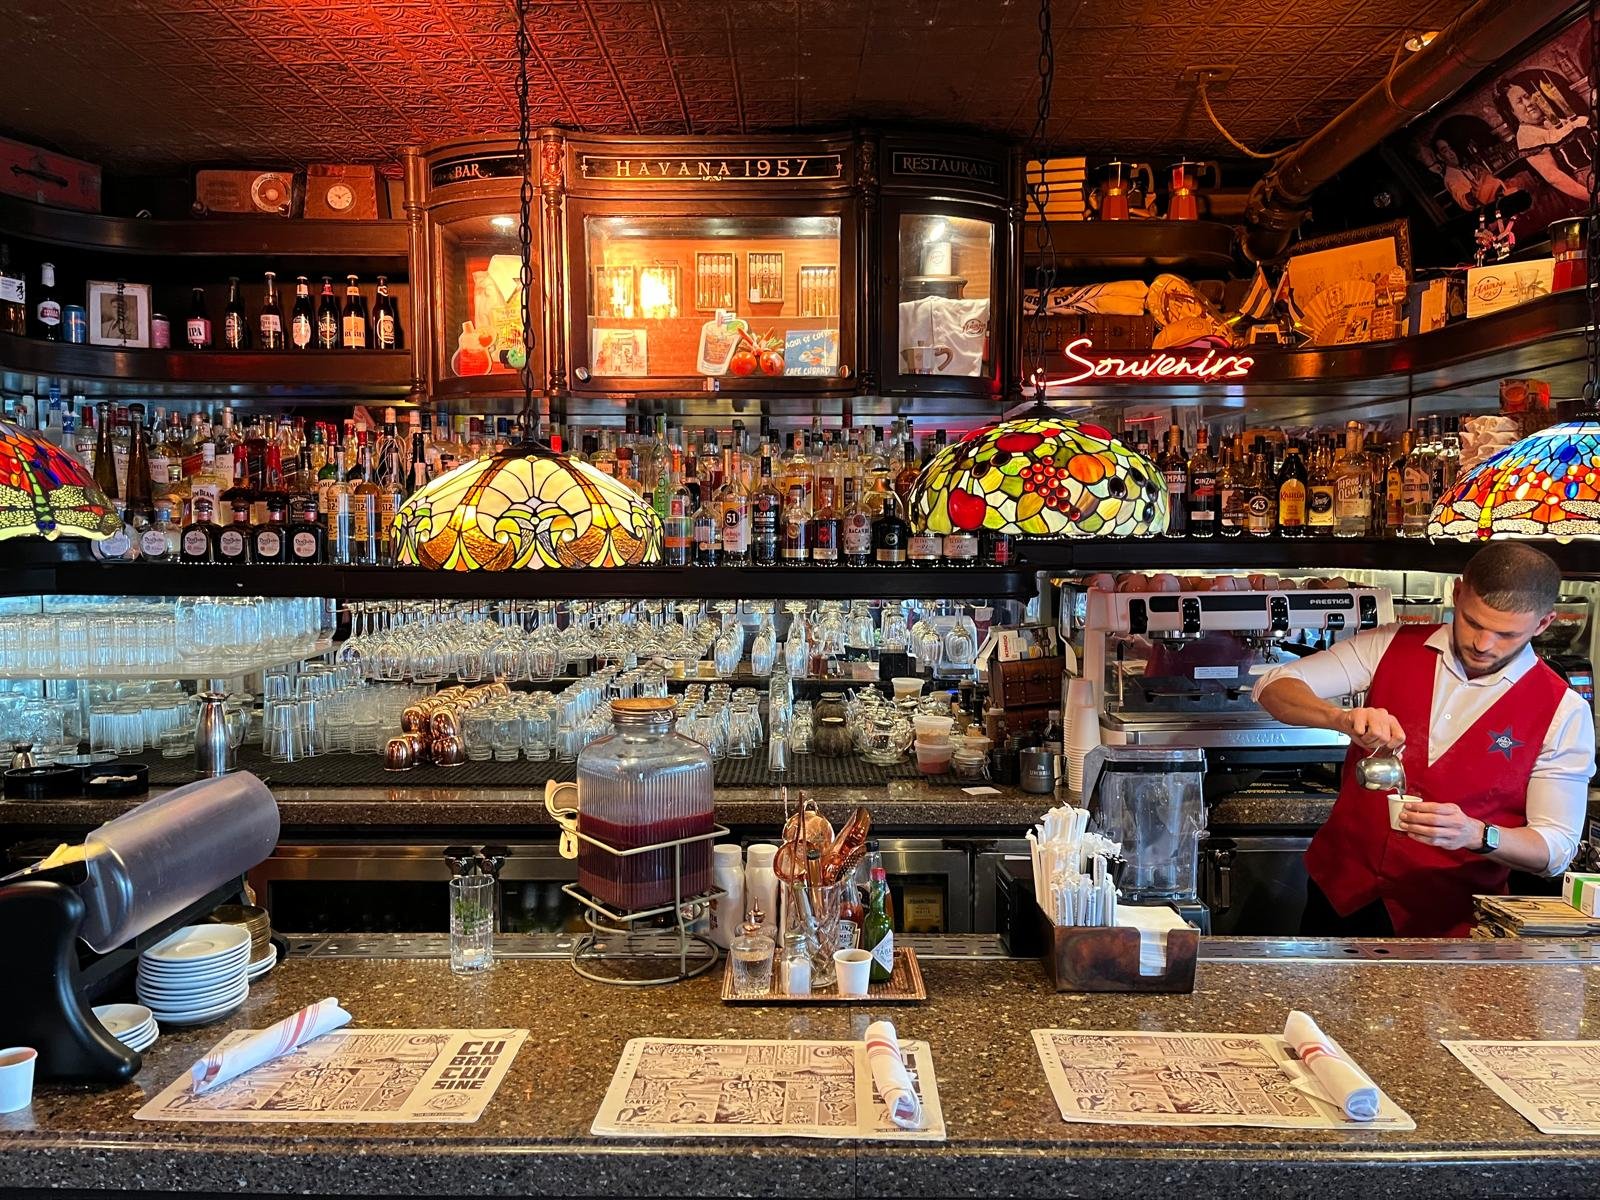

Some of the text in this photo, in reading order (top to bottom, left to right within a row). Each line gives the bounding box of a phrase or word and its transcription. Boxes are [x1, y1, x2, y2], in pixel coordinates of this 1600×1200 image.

[454, 163, 488, 178] BAR
[616, 159, 808, 177] HAVANA 1957
[903, 157, 994, 177] RESTAURANT
[189, 327, 202, 337] IPA
[1031, 338, 1255, 386] Souvenirs
[77, 443, 97, 452] SMIRN
[1252, 500, 1266, 510] 43
[726, 513, 737, 524] 51
[457, 1041, 506, 1055] CU
[449, 1056, 499, 1066] BAN
[439, 1066, 492, 1079] CUI
[431, 1080, 486, 1090] SINE
